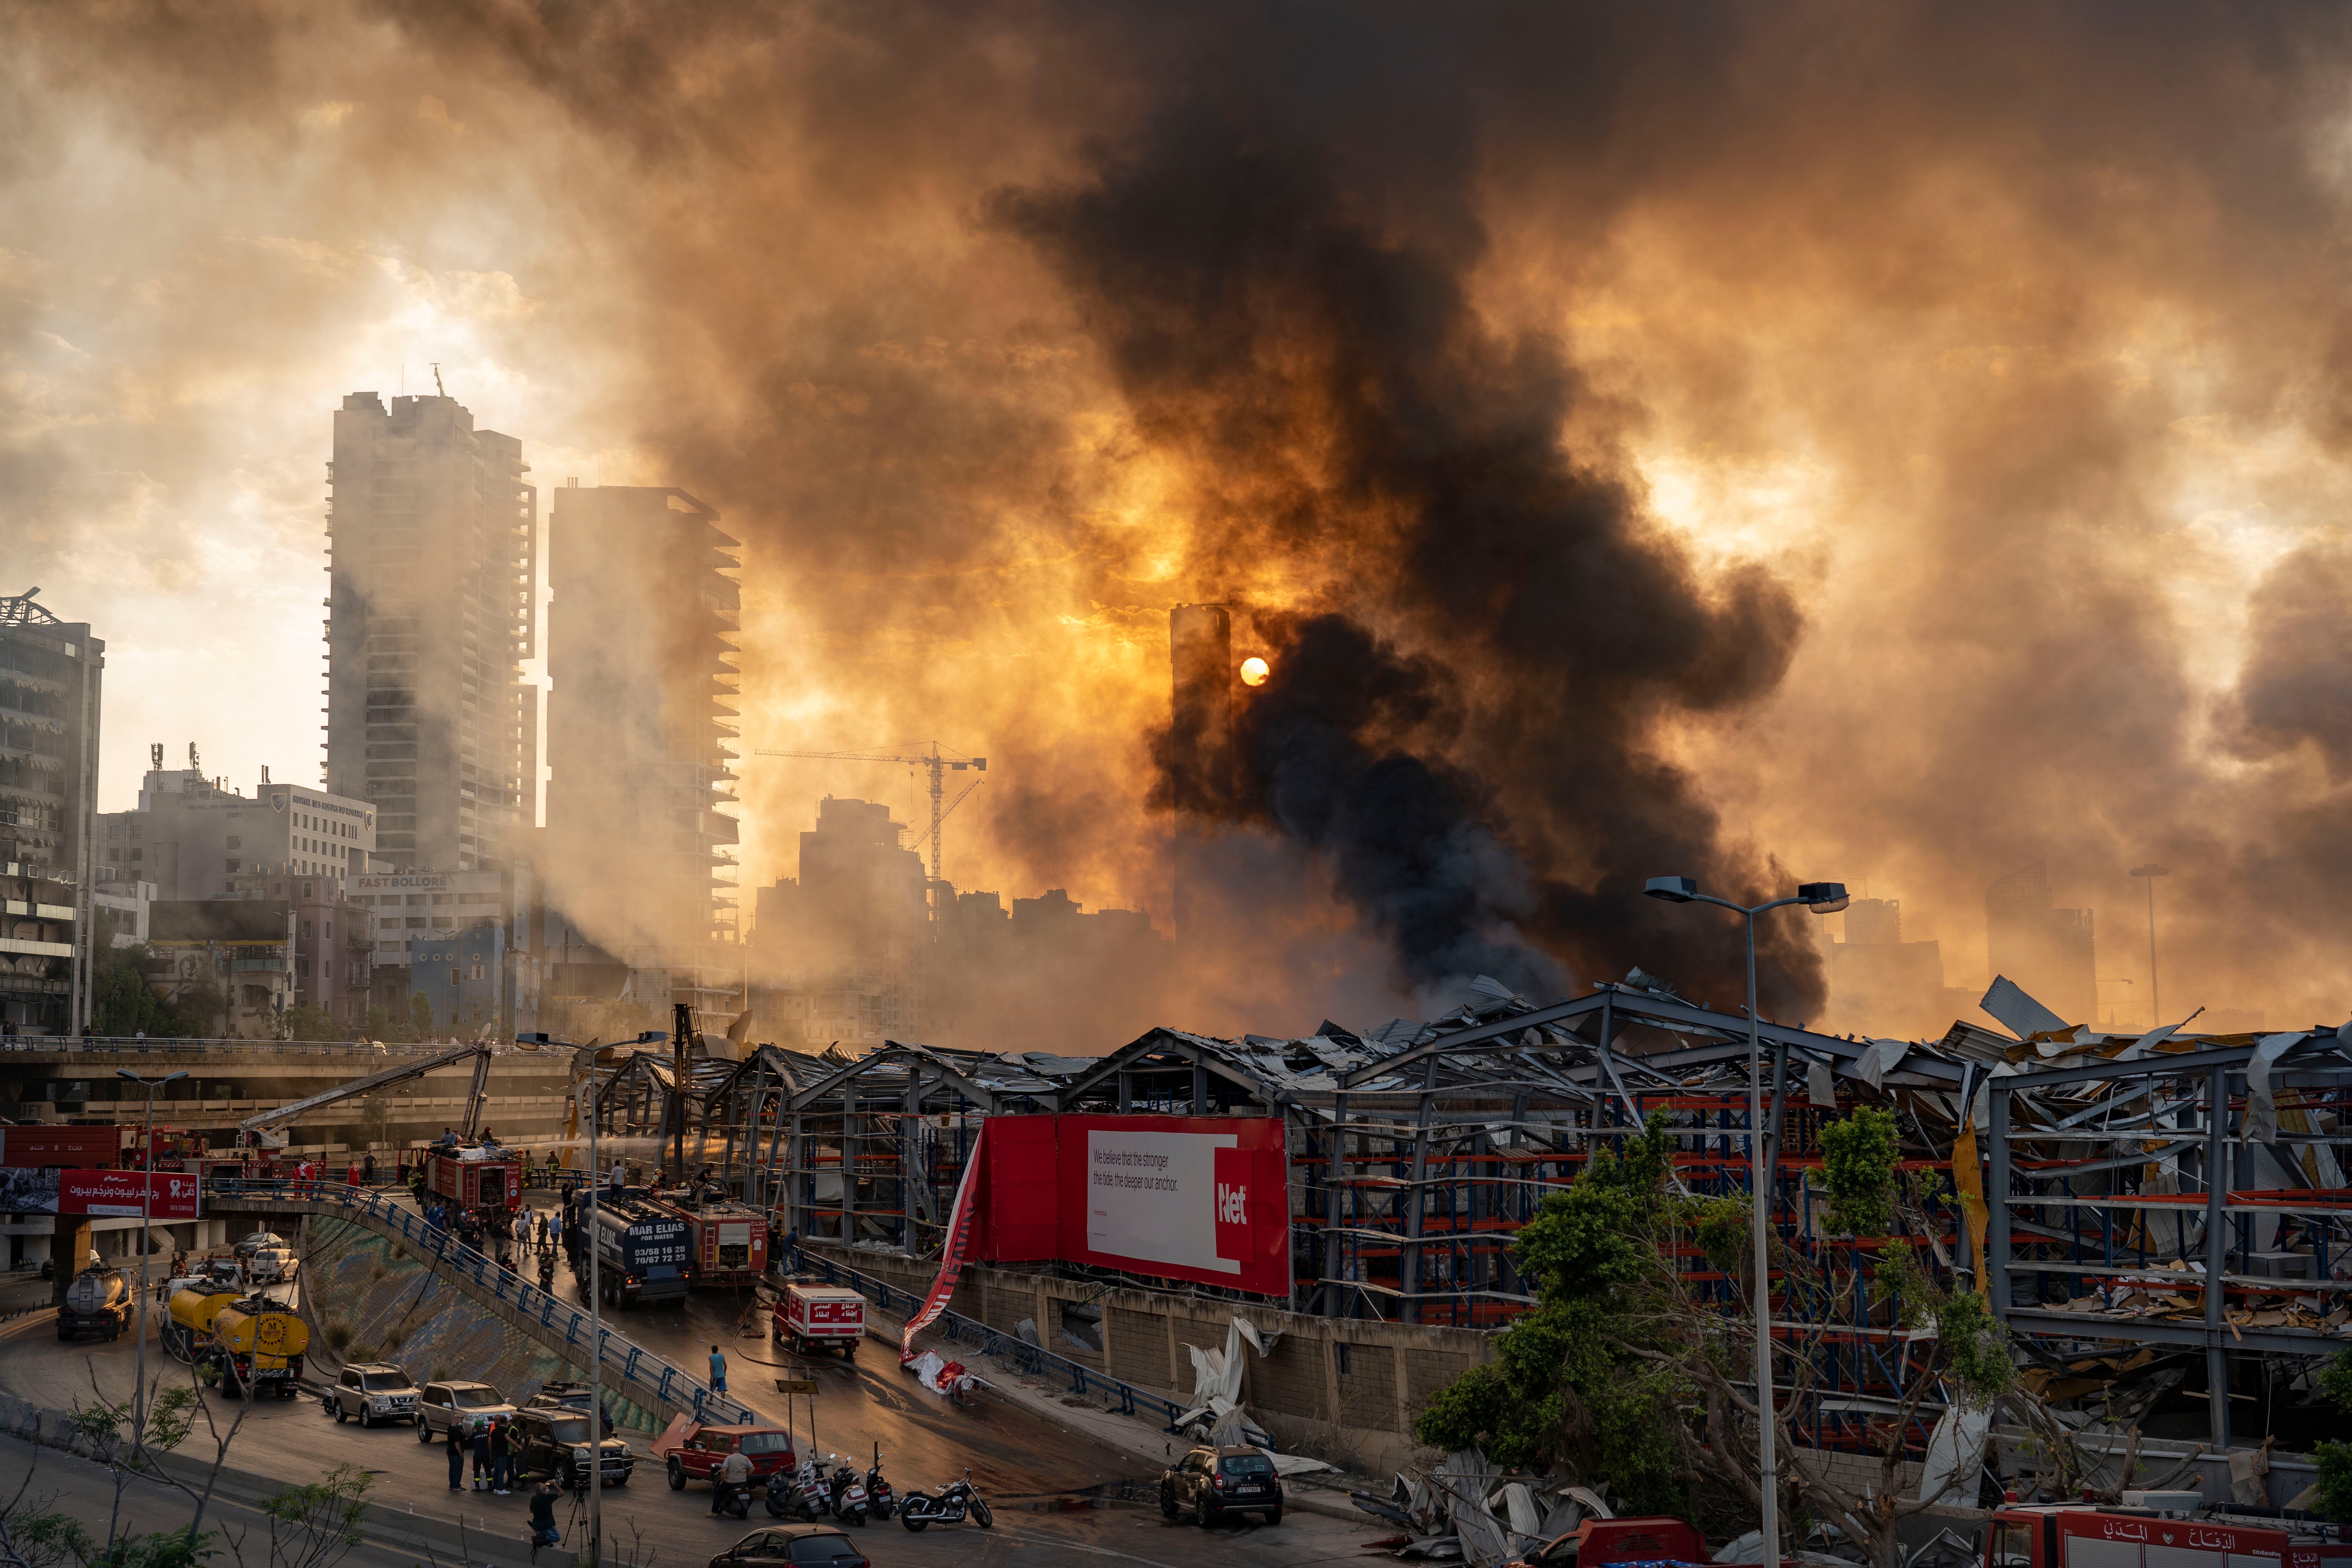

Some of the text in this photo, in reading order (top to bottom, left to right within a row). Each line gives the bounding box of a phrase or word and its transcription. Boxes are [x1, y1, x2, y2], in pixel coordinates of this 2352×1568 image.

[358, 874, 446, 887] FAST BOLLORÉ
[1094, 1149, 1169, 1171] We believe that the stronger
[1094, 1170, 1178, 1192] the tide, the deeper our anchor.
[69, 1185, 92, 1197] بيروت
[630, 1223, 684, 1236] MAR ELIAS
[601, 1226, 615, 1249] ELIAS
[635, 1248, 659, 1256] 03/58
[635, 1256, 659, 1264] 70/67
